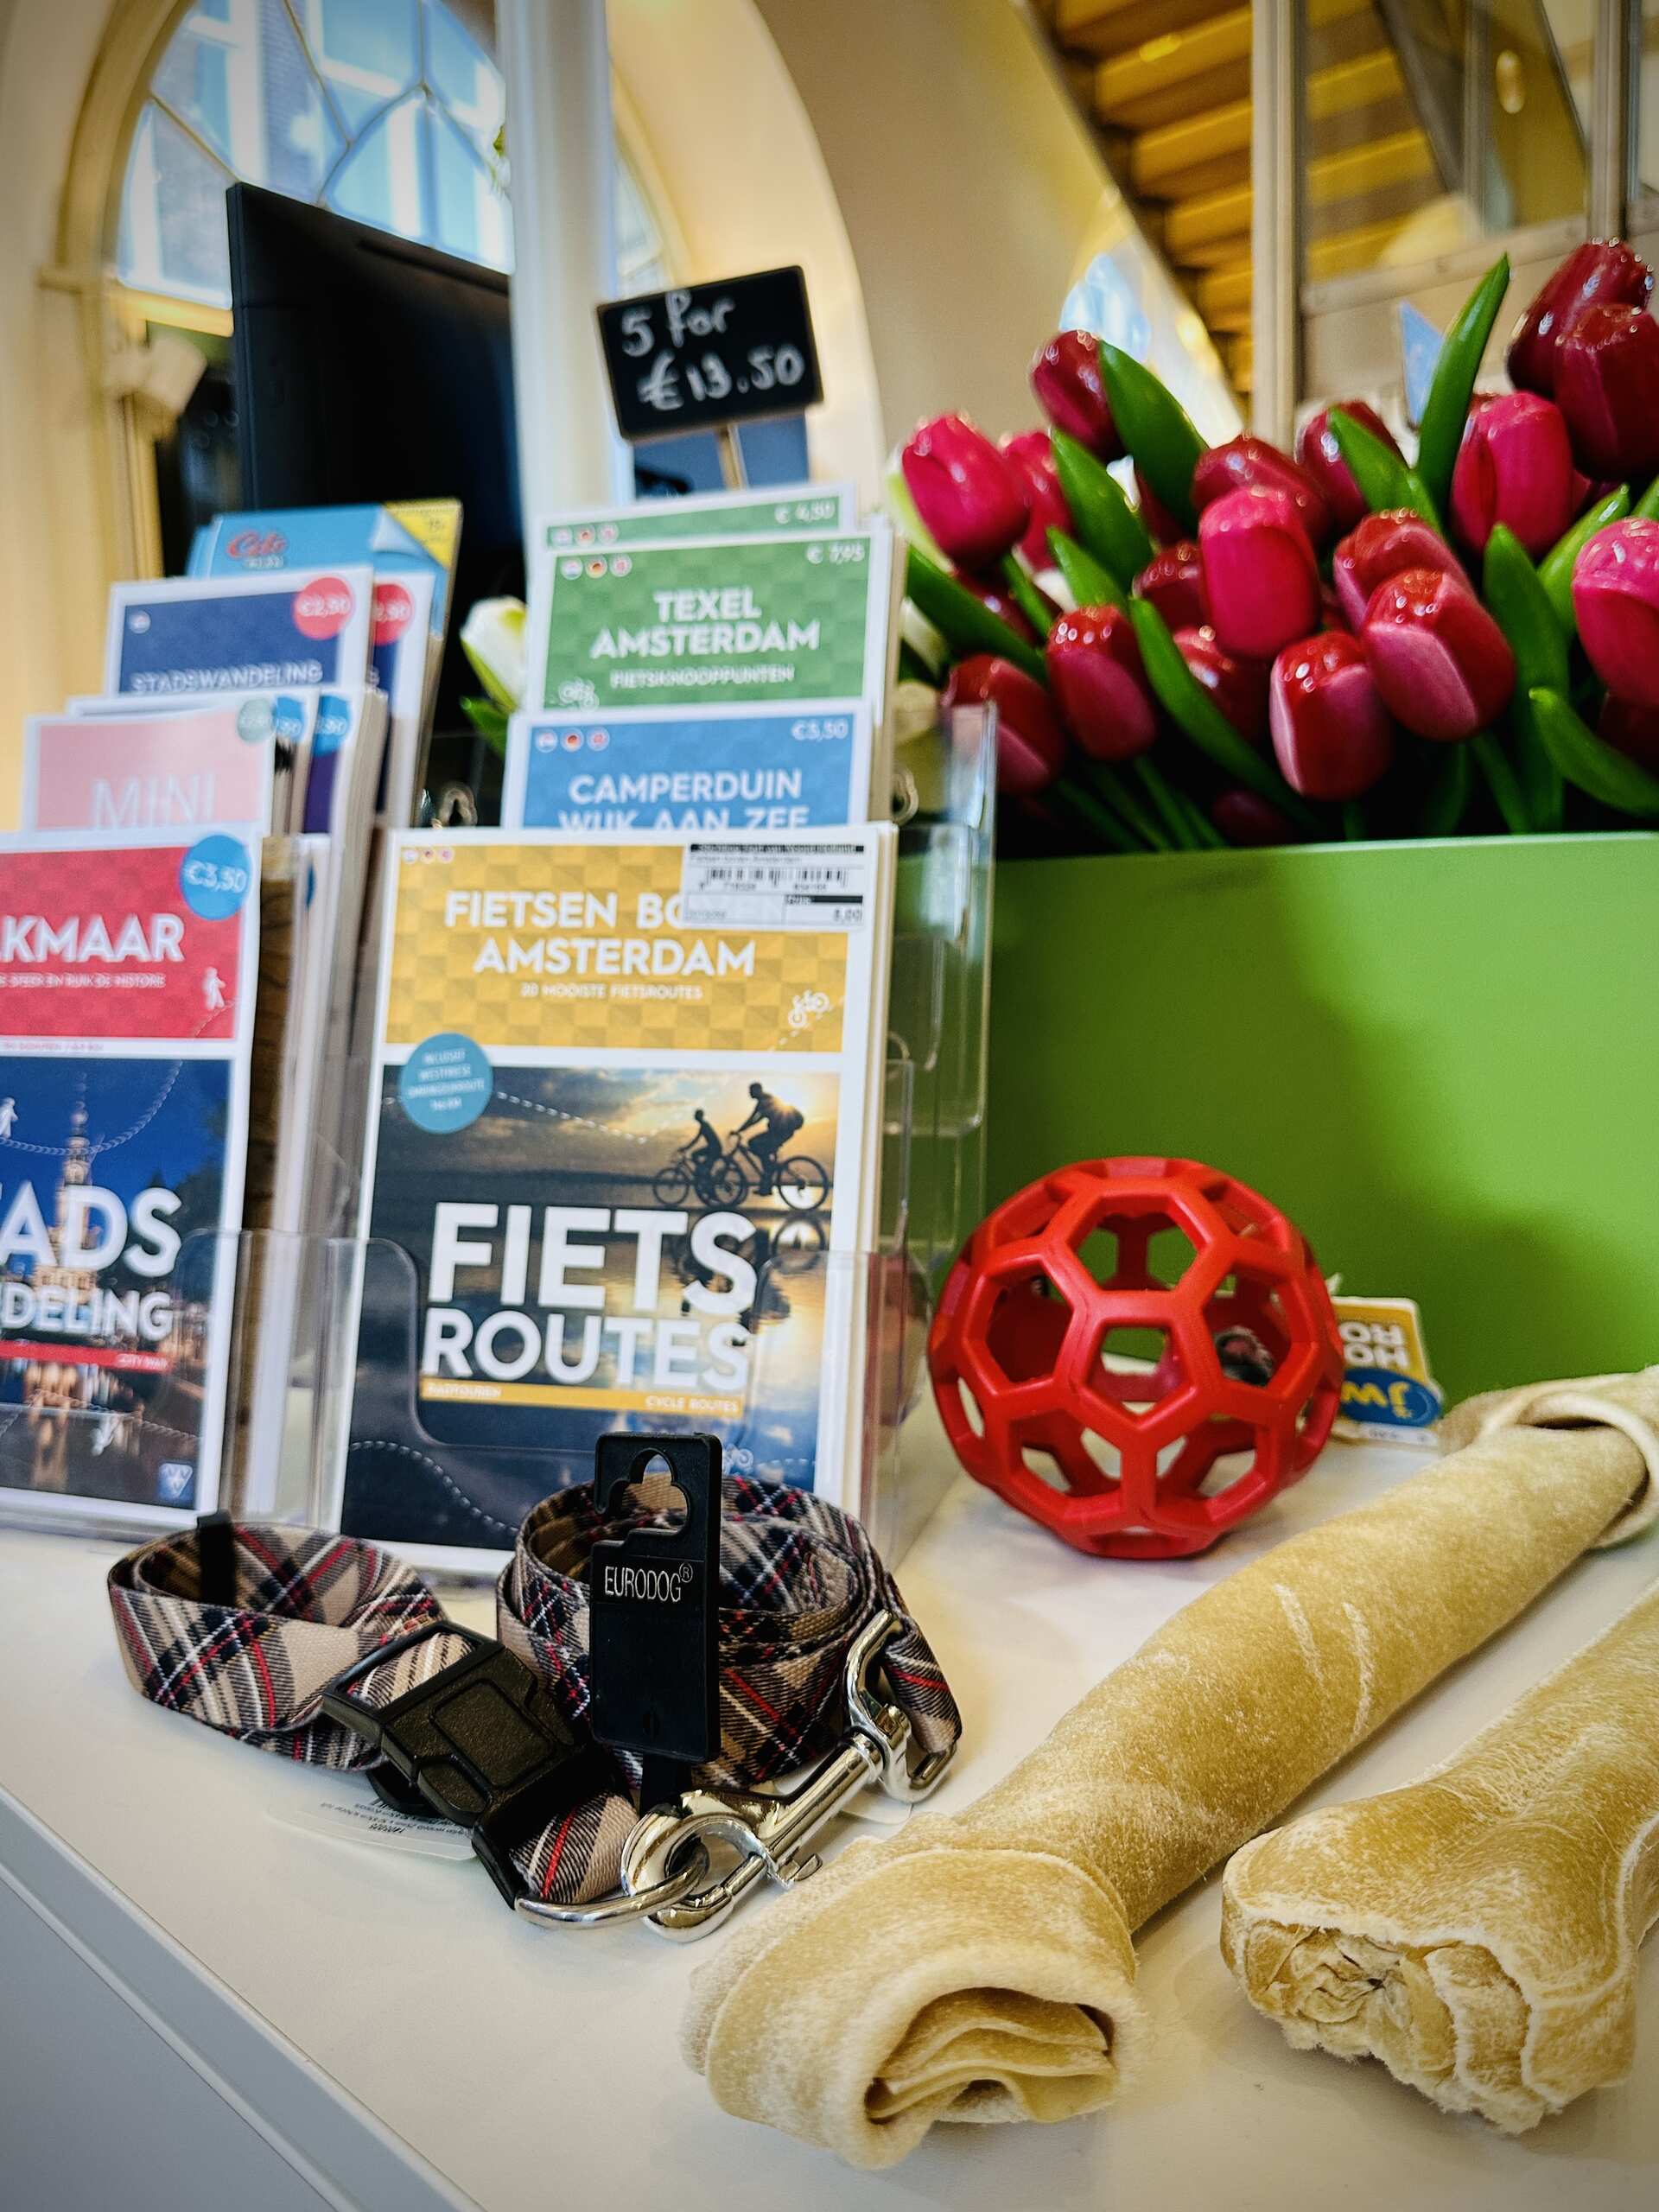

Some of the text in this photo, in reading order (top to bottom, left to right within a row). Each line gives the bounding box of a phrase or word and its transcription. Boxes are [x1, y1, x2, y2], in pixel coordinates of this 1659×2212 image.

[620, 312, 655, 357] 5
[652, 586, 762, 623] TEXEL
[588, 620, 821, 661] AMSTERDAM
[130, 659, 323, 694] STADSWANDELING
[610, 664, 796, 689] FIETSKNOOPPUNTEN
[92, 773, 217, 829] MINI
[567, 767, 802, 808] CAMPERDUIN
[652, 807, 731, 830] AAN
[743, 804, 810, 830] ZEE
[184, 859, 249, 893] €3,50
[445, 891, 618, 929] FIETSEN
[472, 937, 756, 976] AMSTERDAM
[610, 983, 703, 1001] FIETSROUTES
[0, 1180, 182, 1278] ADS
[428, 1201, 759, 1315] FIETS
[421, 1306, 752, 1392] ROUTES
[645, 1395, 740, 1414] CYCLE ROUTES
